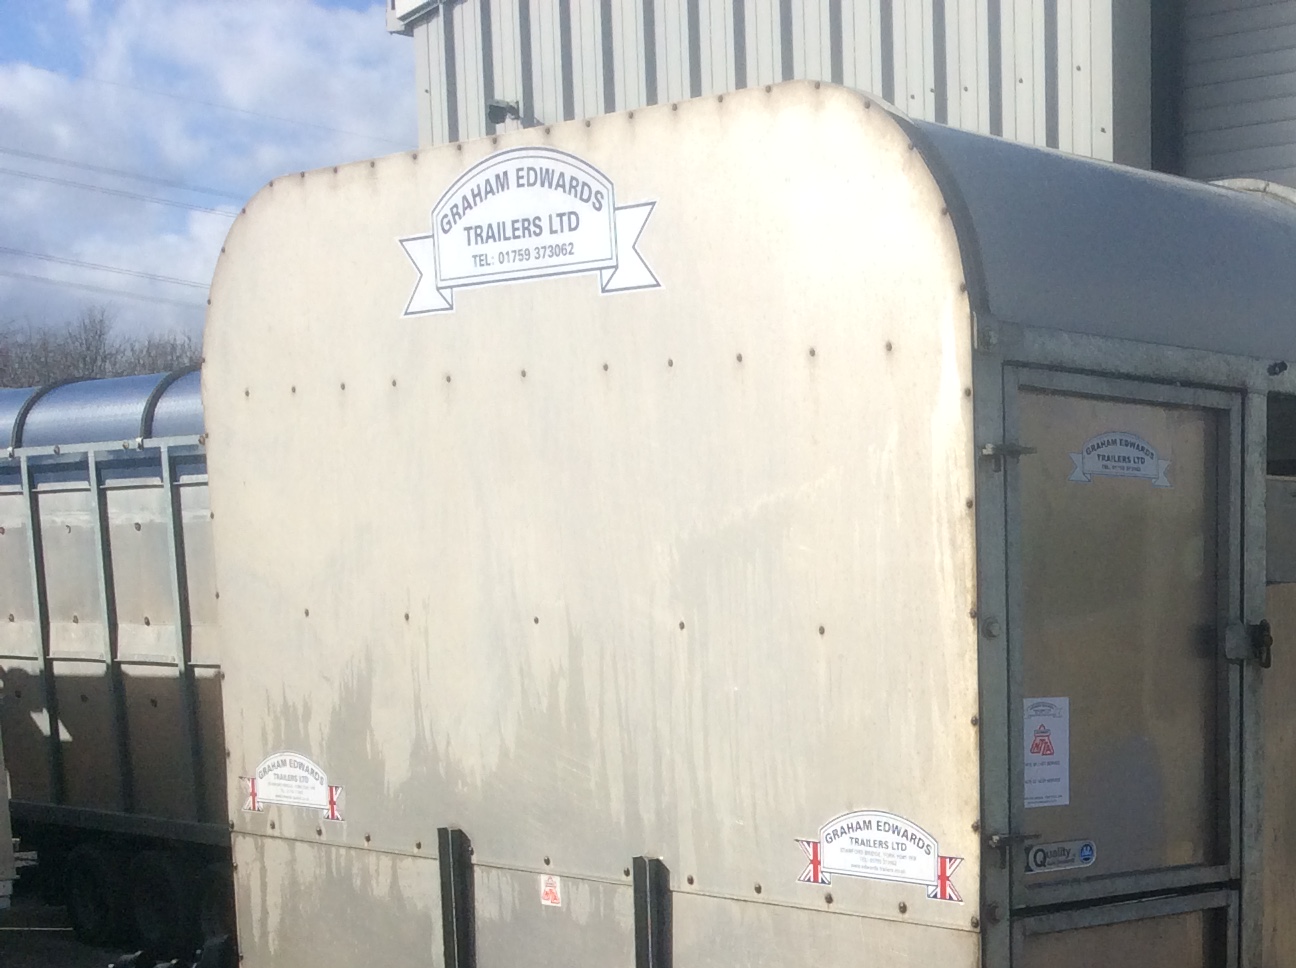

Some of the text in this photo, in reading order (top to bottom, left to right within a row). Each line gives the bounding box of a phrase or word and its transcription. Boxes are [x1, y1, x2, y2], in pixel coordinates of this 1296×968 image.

[440, 166, 605, 235] GRAHAM EDWARDS
[464, 211, 580, 247] TRAILERS LTD
[472, 242, 574, 267] TEL: 01759 373062
[1086, 438, 1154, 460] GRAHAM EDWARDS
[1097, 453, 1146, 464] TRAILERS LTD
[258, 758, 324, 786] GRAHAM EDWARDS
[824, 820, 932, 856] GRAHAM EDWARDS
[849, 836, 907, 852] TRAILERS LTD
[1033, 846, 1072, 867] Quality
